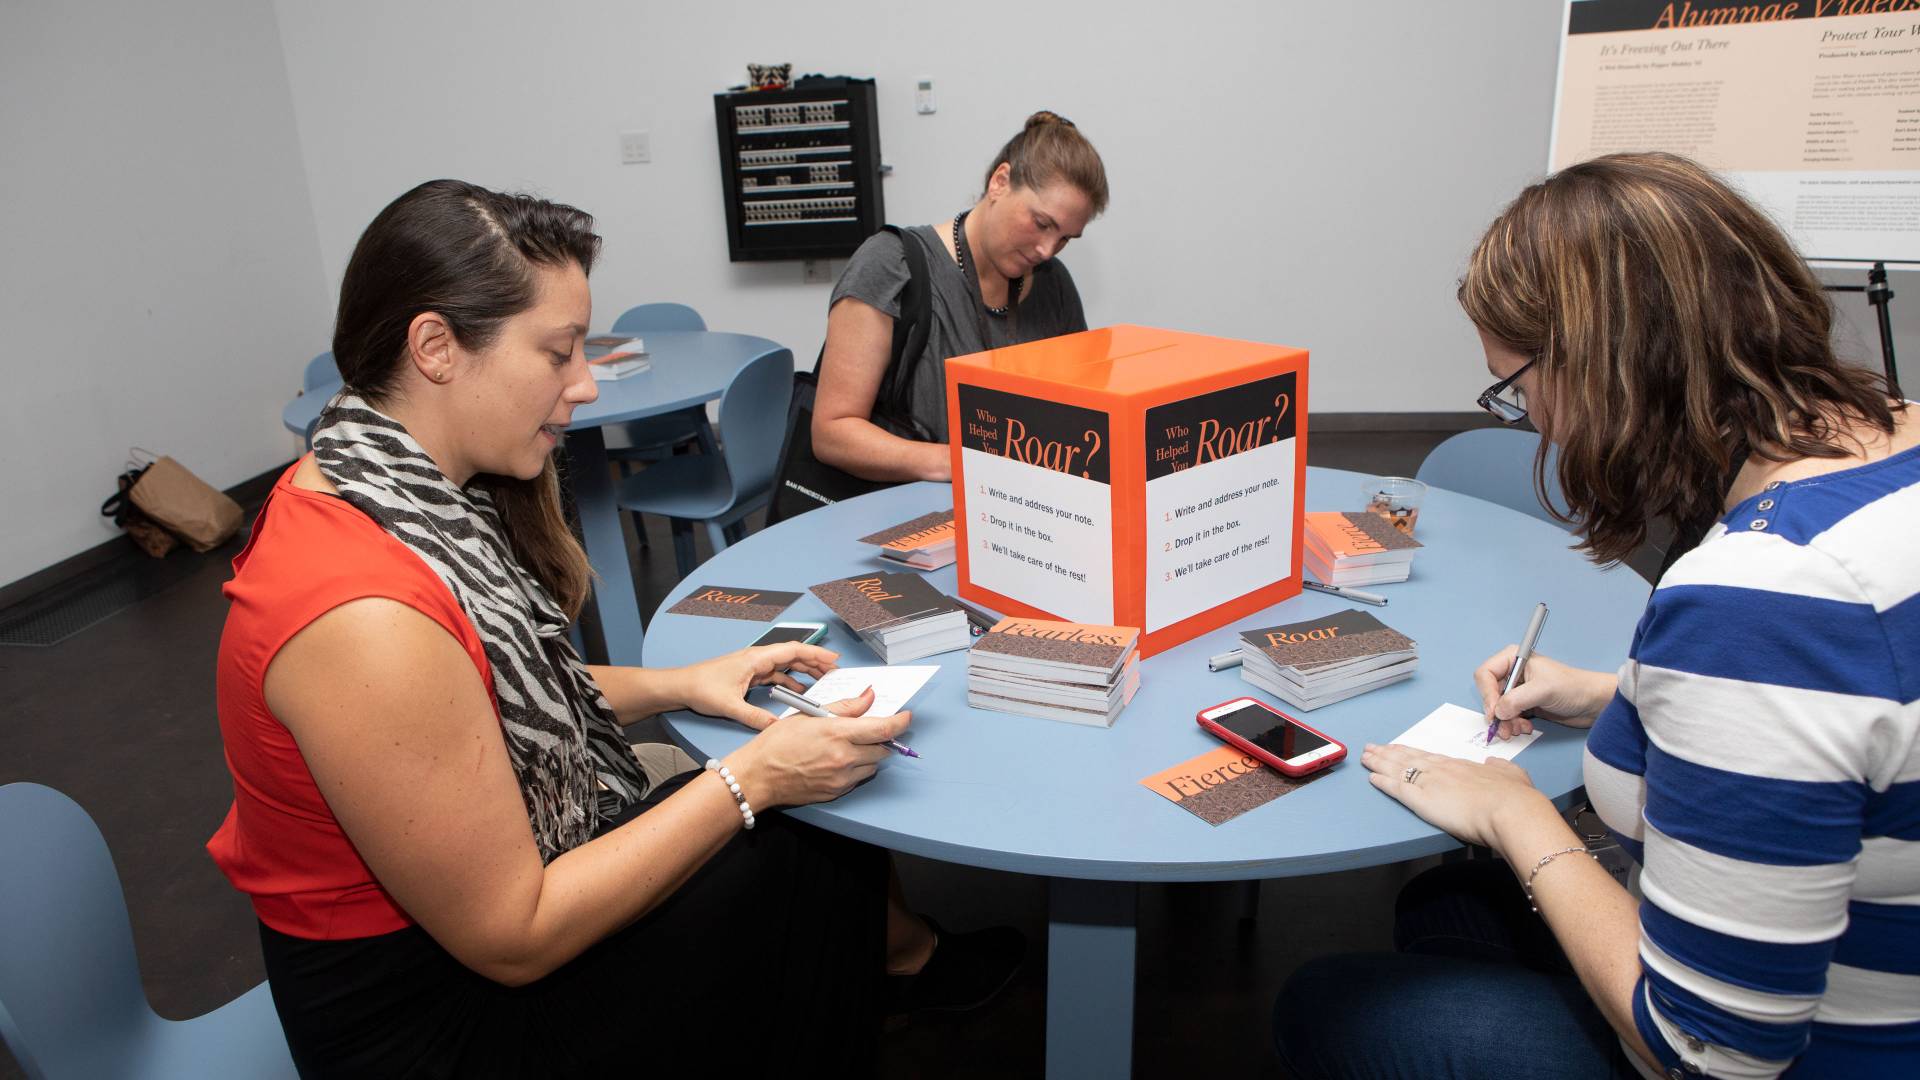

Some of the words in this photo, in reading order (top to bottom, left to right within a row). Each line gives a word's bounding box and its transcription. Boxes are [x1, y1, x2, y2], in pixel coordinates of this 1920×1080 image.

[1653, 2, 1799, 29] Alumnae
[1820, 30, 1868, 42] Protect
[1874, 26, 1906, 38] Your
[1600, 45, 1617, 56] It's
[1620, 42, 1668, 56] Freezing
[1670, 40, 1694, 52] Out
[1697, 38, 1730, 50] There
[976, 408, 997, 424] Who
[968, 424, 998, 440] Helped
[1166, 426, 1189, 440] Who
[1194, 394, 1289, 467] Roar?
[982, 442, 999, 456] You
[1004, 418, 1100, 480] Roar?
[1156, 441, 1189, 462] Helped
[1171, 462, 1188, 473] You
[980, 485, 986, 496] 1.
[988, 488, 1008, 500] Write
[1009, 494, 1022, 505] and
[1024, 498, 1054, 514] address
[1056, 508, 1072, 520] your
[1074, 514, 1094, 526] note.
[1164, 512, 1172, 522] 1.
[1175, 504, 1196, 518] Write
[1198, 498, 1212, 511] and
[1214, 489, 1243, 506] address
[1244, 484, 1261, 496] your
[1262, 478, 1280, 490] note.
[886, 523, 954, 547] lourish
[990, 515, 1006, 528] Drop
[1008, 521, 1014, 531] it
[1016, 524, 1022, 532] in
[1024, 526, 1036, 538] the
[1038, 531, 1054, 542] box.
[1164, 542, 1172, 552] 2.
[1176, 536, 1194, 548] Drop
[1196, 532, 1201, 541] it
[1202, 529, 1210, 538] in
[1212, 524, 1224, 536] the
[1226, 520, 1240, 530] box.
[992, 542, 1008, 556] We'll
[1010, 550, 1026, 562] take
[1028, 556, 1043, 568] care
[1045, 562, 1052, 570] of
[1054, 564, 1066, 576] the
[1069, 570, 1086, 582] rest!
[1165, 572, 1172, 582] 3.
[1175, 563, 1193, 578] We'll
[1196, 558, 1212, 570] take
[1214, 551, 1230, 564] care
[1232, 546, 1239, 556] of
[1242, 542, 1252, 553] the
[1254, 535, 1270, 548] rest!
[696, 590, 760, 604] Real
[851, 578, 903, 604] Real
[1001, 622, 1122, 646] Fearless
[1264, 626, 1340, 648] Roar
[1164, 755, 1264, 799] Fierce
